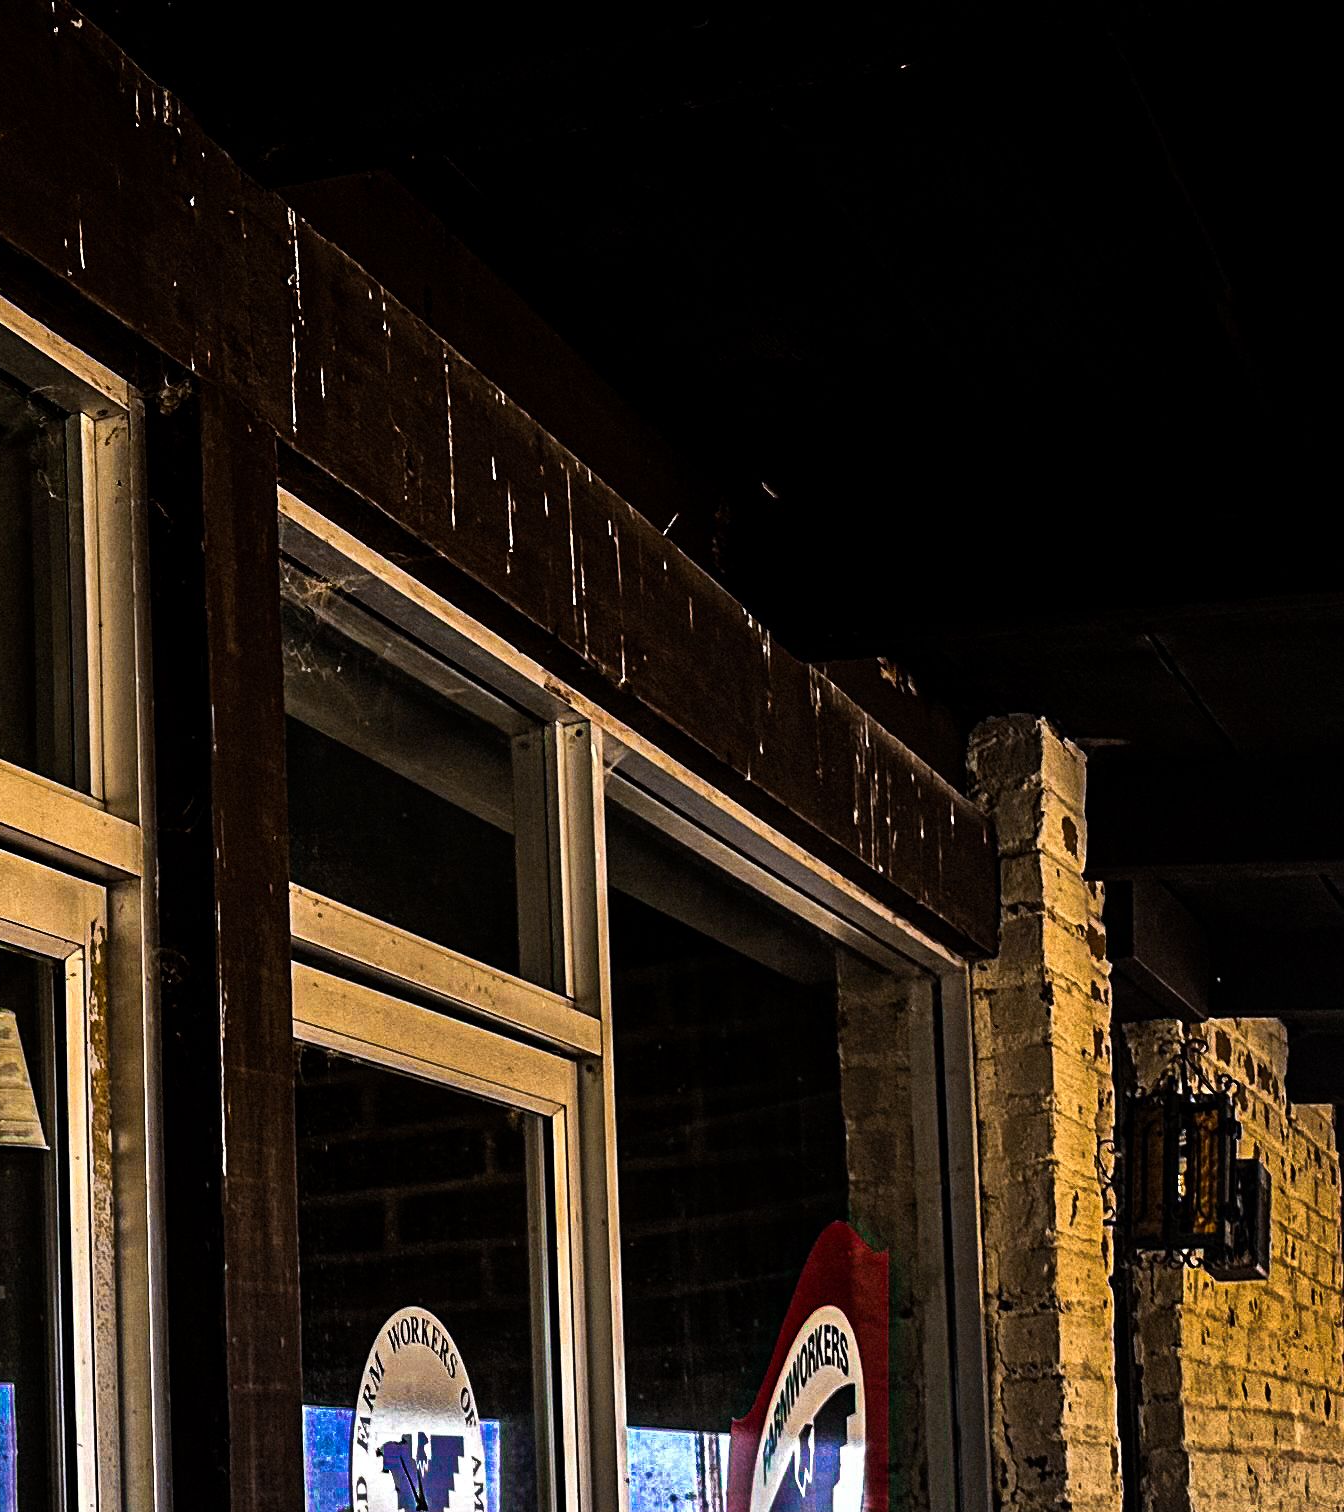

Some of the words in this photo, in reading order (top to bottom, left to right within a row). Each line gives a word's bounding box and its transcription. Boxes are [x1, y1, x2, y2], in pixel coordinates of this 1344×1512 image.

[356, 1351, 385, 1454] FARM
[387, 1316, 458, 1378] WORKERS
[460, 1387, 477, 1427] OF
